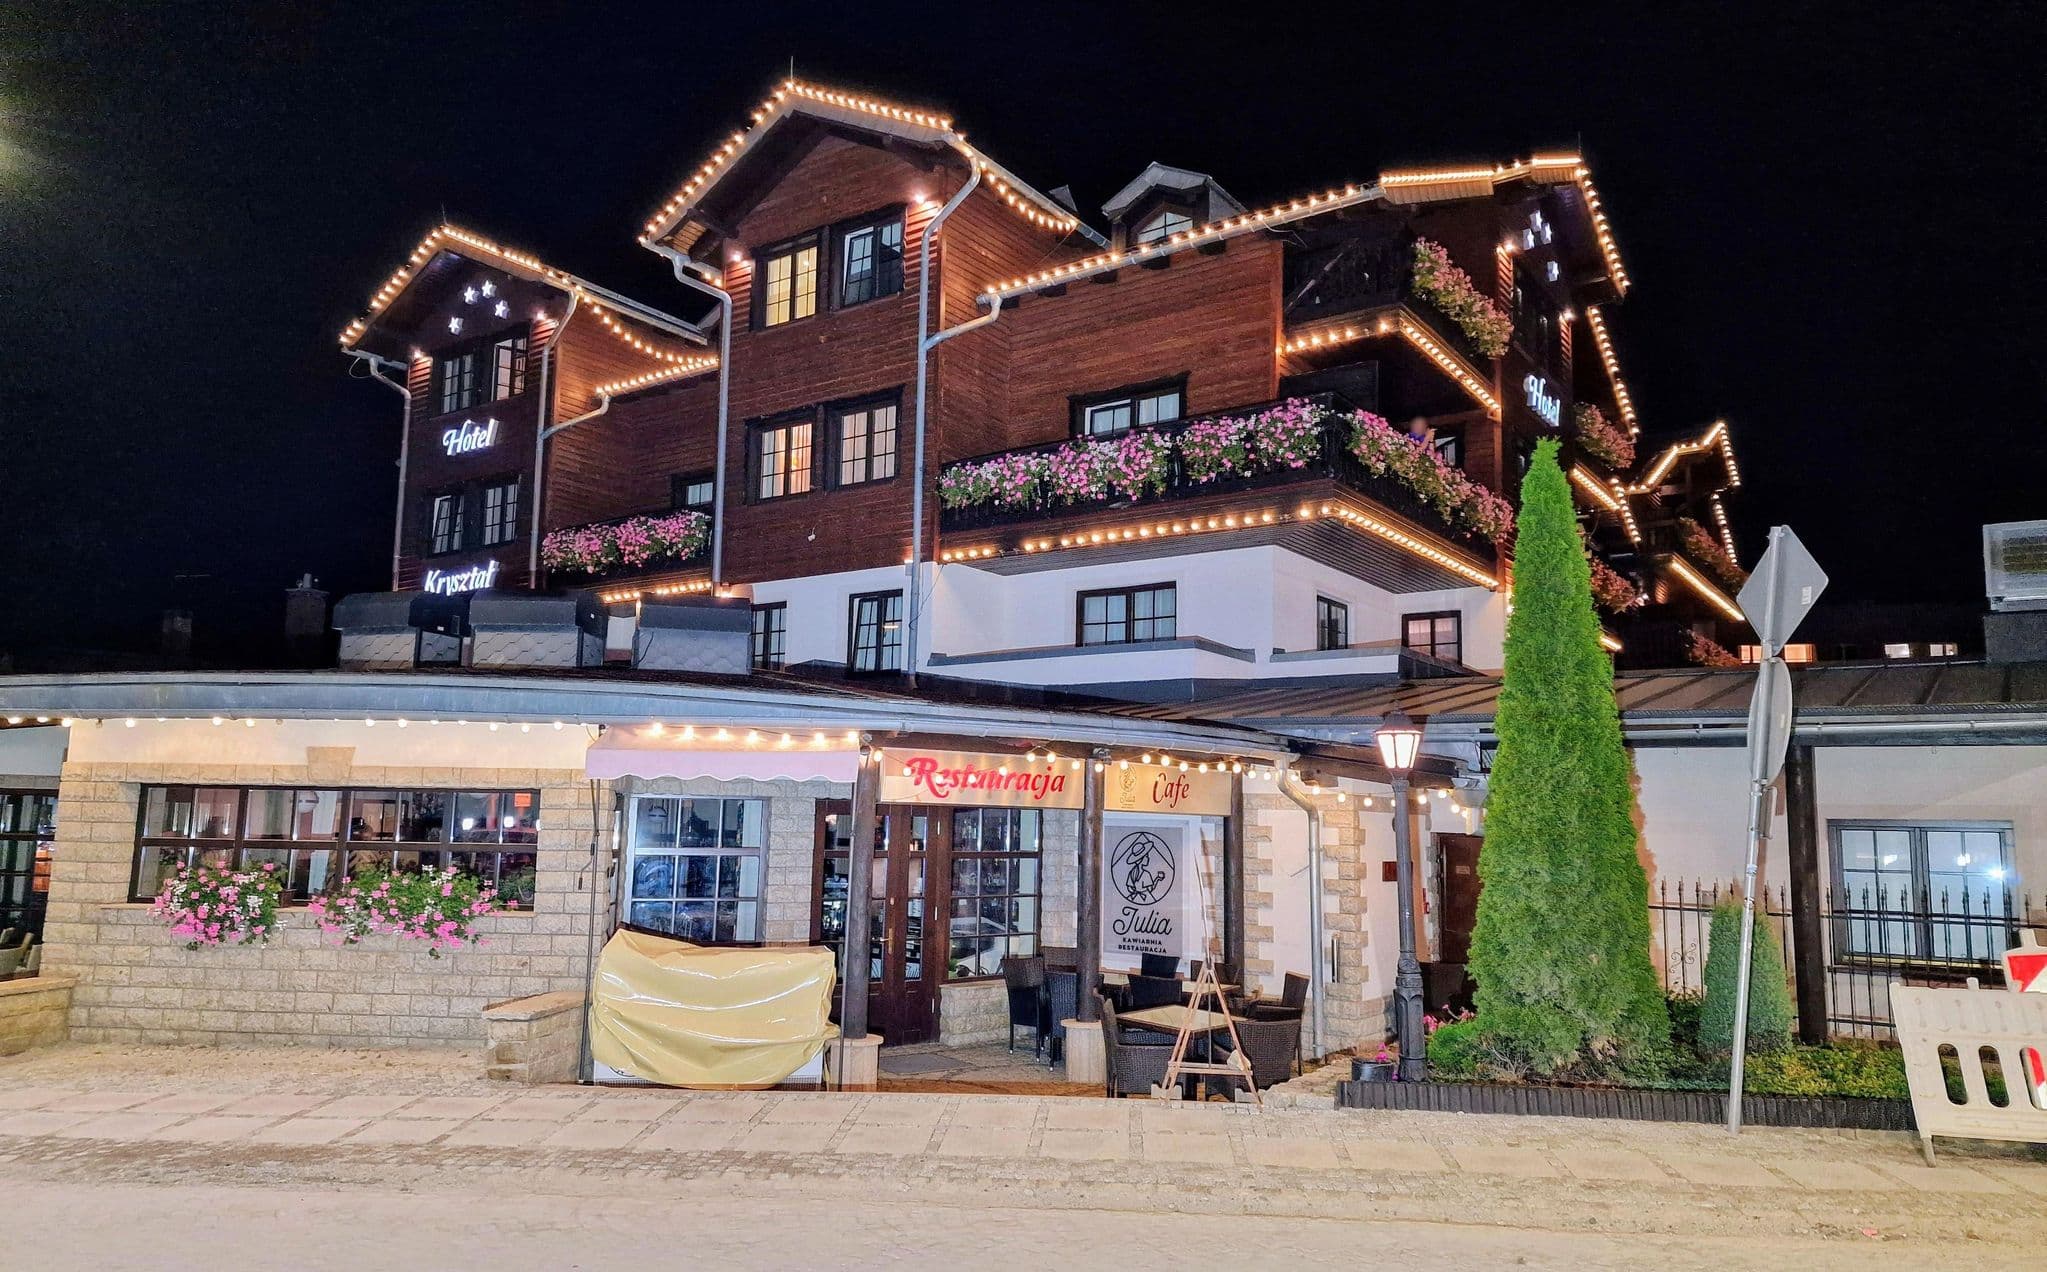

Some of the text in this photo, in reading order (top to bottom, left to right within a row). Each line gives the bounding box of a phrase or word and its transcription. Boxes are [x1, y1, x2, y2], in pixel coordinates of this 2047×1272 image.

[1523, 374, 1561, 427] Hotel
[442, 418, 498, 456] Hotel
[906, 757, 1065, 800] Restauracja
[1152, 772, 1190, 808] Cafe
[1112, 906, 1172, 935] Julia
[1118, 944, 1167, 953] RESTAURACJA
[1122, 937, 1162, 945] KAWIARNIA
